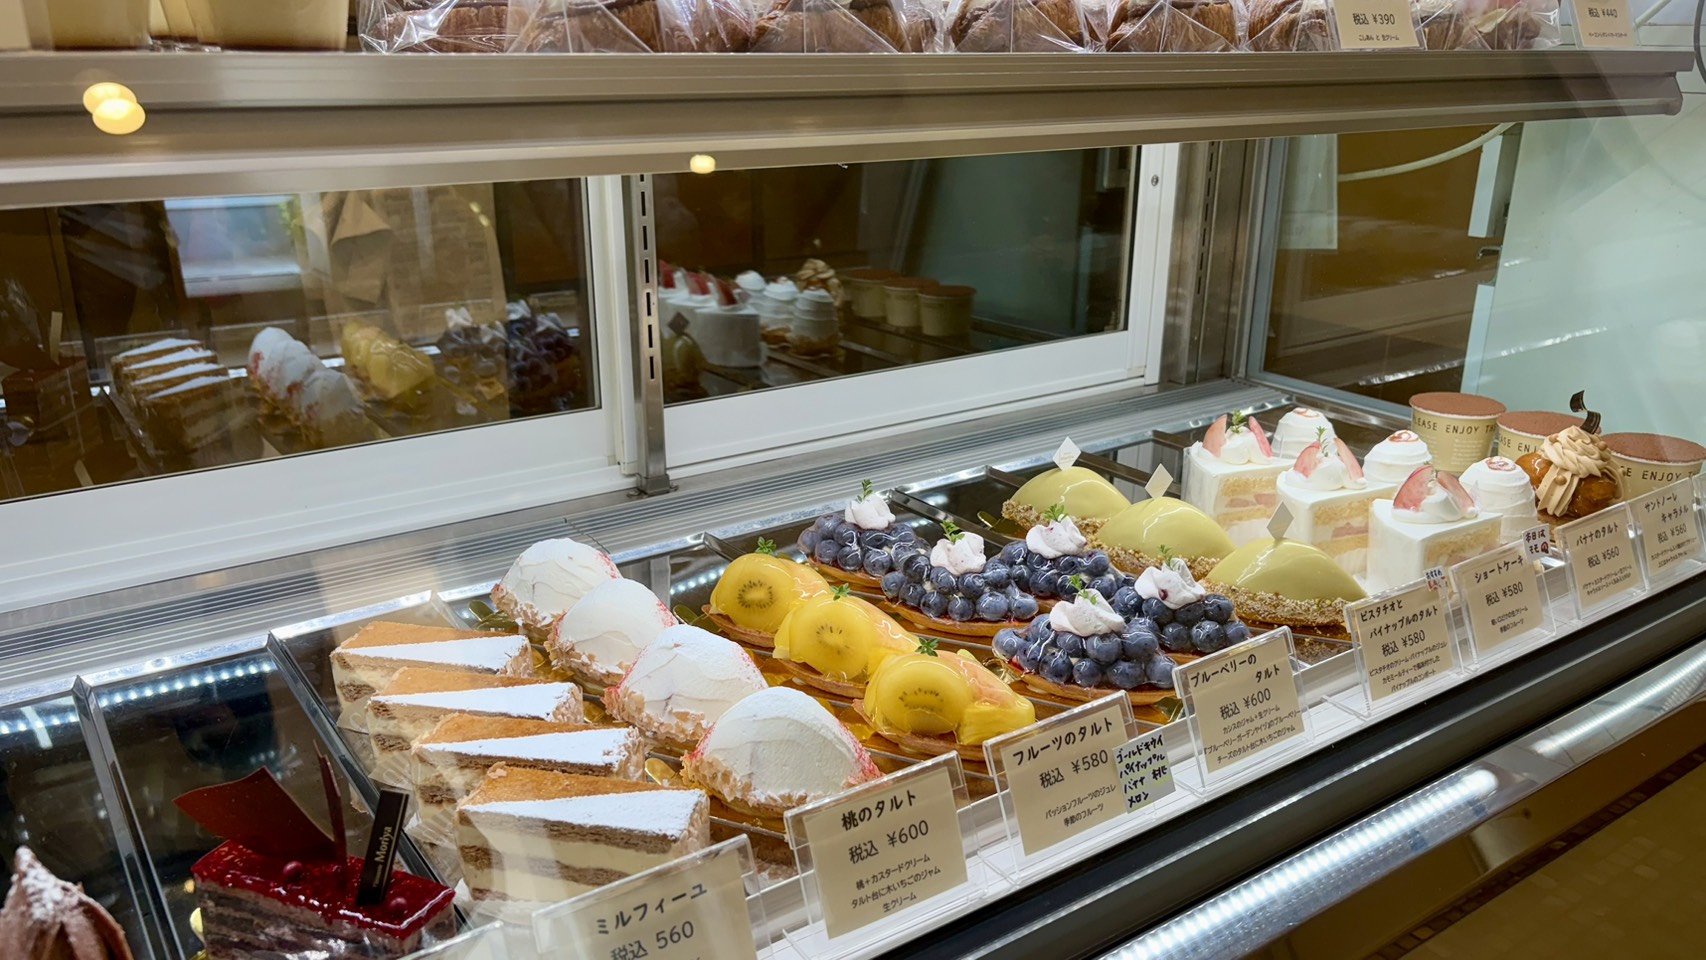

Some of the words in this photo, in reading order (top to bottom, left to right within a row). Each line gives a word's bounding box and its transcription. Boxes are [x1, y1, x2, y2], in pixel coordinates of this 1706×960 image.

[1352, 12, 1370, 25] 税込
[1371, 13, 1396, 25] ¥390
[1445, 424, 1480, 435] ENJOY
[1641, 470, 1681, 482] ENJOY
[1576, 522, 1619, 546] バナナのタルト
[1474, 554, 1524, 583] ショートケーキ
[1601, 546, 1620, 562] ¥560
[1485, 591, 1501, 606] 税込
[1501, 581, 1524, 598] ¥580
[1360, 599, 1404, 622] ピスタチオと
[1369, 605, 1439, 639] パイナップルのタルト
[1381, 640, 1400, 657] 税込
[1400, 629, 1426, 648] ¥580
[1190, 653, 1257, 687] ブルーベリーの
[1255, 664, 1280, 683] タルト
[1219, 701, 1240, 721] 税込
[1242, 687, 1271, 709] ¥600
[1012, 716, 1113, 766] フルーツのタルト
[1039, 767, 1065, 789] 税込
[1071, 749, 1109, 775] ¥580
[1120, 753, 1165, 778] パイナップル
[841, 789, 916, 831] 桃のタルト
[1045, 783, 1117, 819] パッションフルーツのジュレ
[1128, 791, 1149, 808] メロン
[374, 826, 393, 863] Moriya
[848, 840, 879, 864] 税込
[886, 819, 929, 848] ¥600
[851, 866, 941, 909] タルト台に木いちごのジャム
[882, 891, 917, 912] 生クリーム
[597, 883, 708, 934] ミルフィーユ
[655, 920, 694, 949] 560
